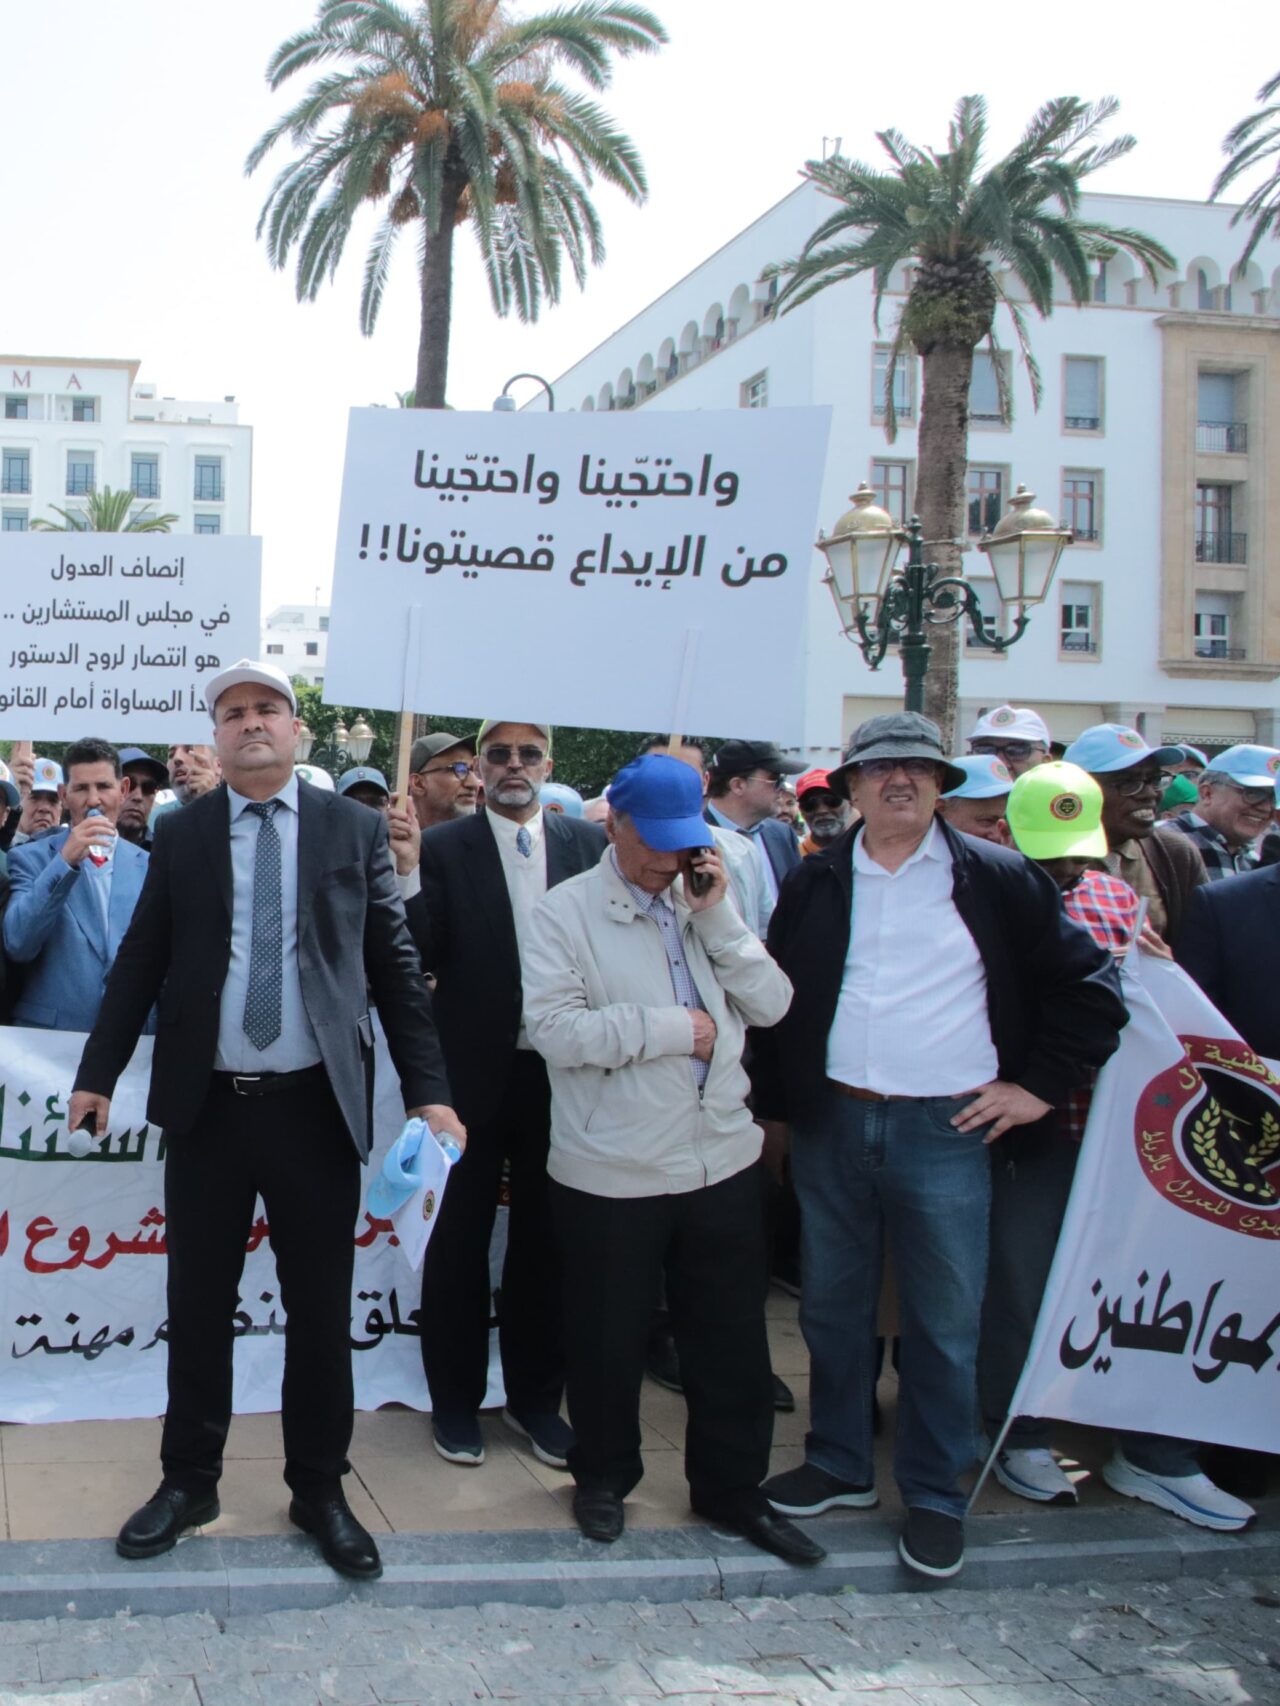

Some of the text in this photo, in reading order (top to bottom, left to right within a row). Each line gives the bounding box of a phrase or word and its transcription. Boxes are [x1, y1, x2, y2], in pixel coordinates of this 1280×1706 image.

[51, 554, 185, 586] إنصاف العدول
[569, 533, 707, 590] الإيداع
[720, 545, 788, 587] من
[22, 598, 129, 626] المستشارين
[136, 600, 194, 628] مجلس
[200, 603, 231, 637] في
[9, 643, 221, 672] هو انتصار لروح الدستور
[53, 682, 94, 715] أمام
[101, 688, 182, 715] المساواة
[190, 683, 208, 712] دأ
[1204, 1043, 1280, 1086] وطنية
[23, 1206, 167, 1274] شروع
[11, 1312, 135, 1360] مهنة
[1060, 1268, 1280, 1384] مواطنين
